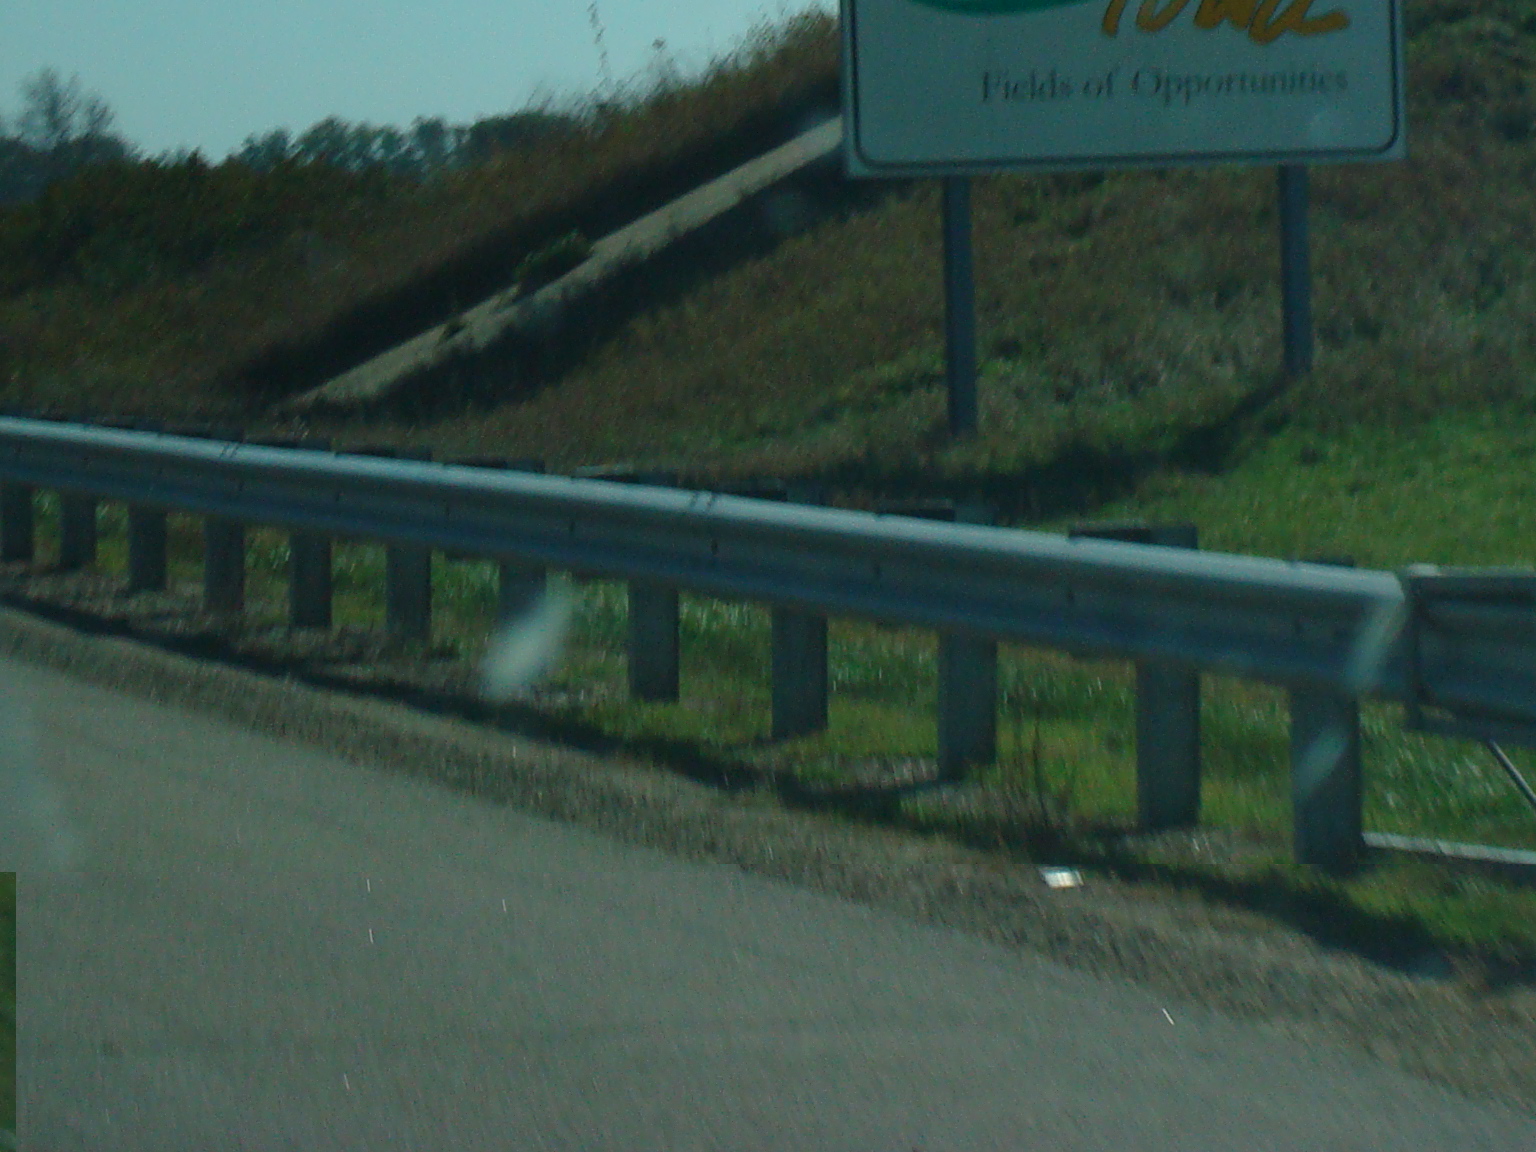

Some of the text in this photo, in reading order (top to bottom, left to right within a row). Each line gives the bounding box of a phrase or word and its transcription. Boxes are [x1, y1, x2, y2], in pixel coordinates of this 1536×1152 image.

[981, 66, 1349, 106] Fields of Opportunities
